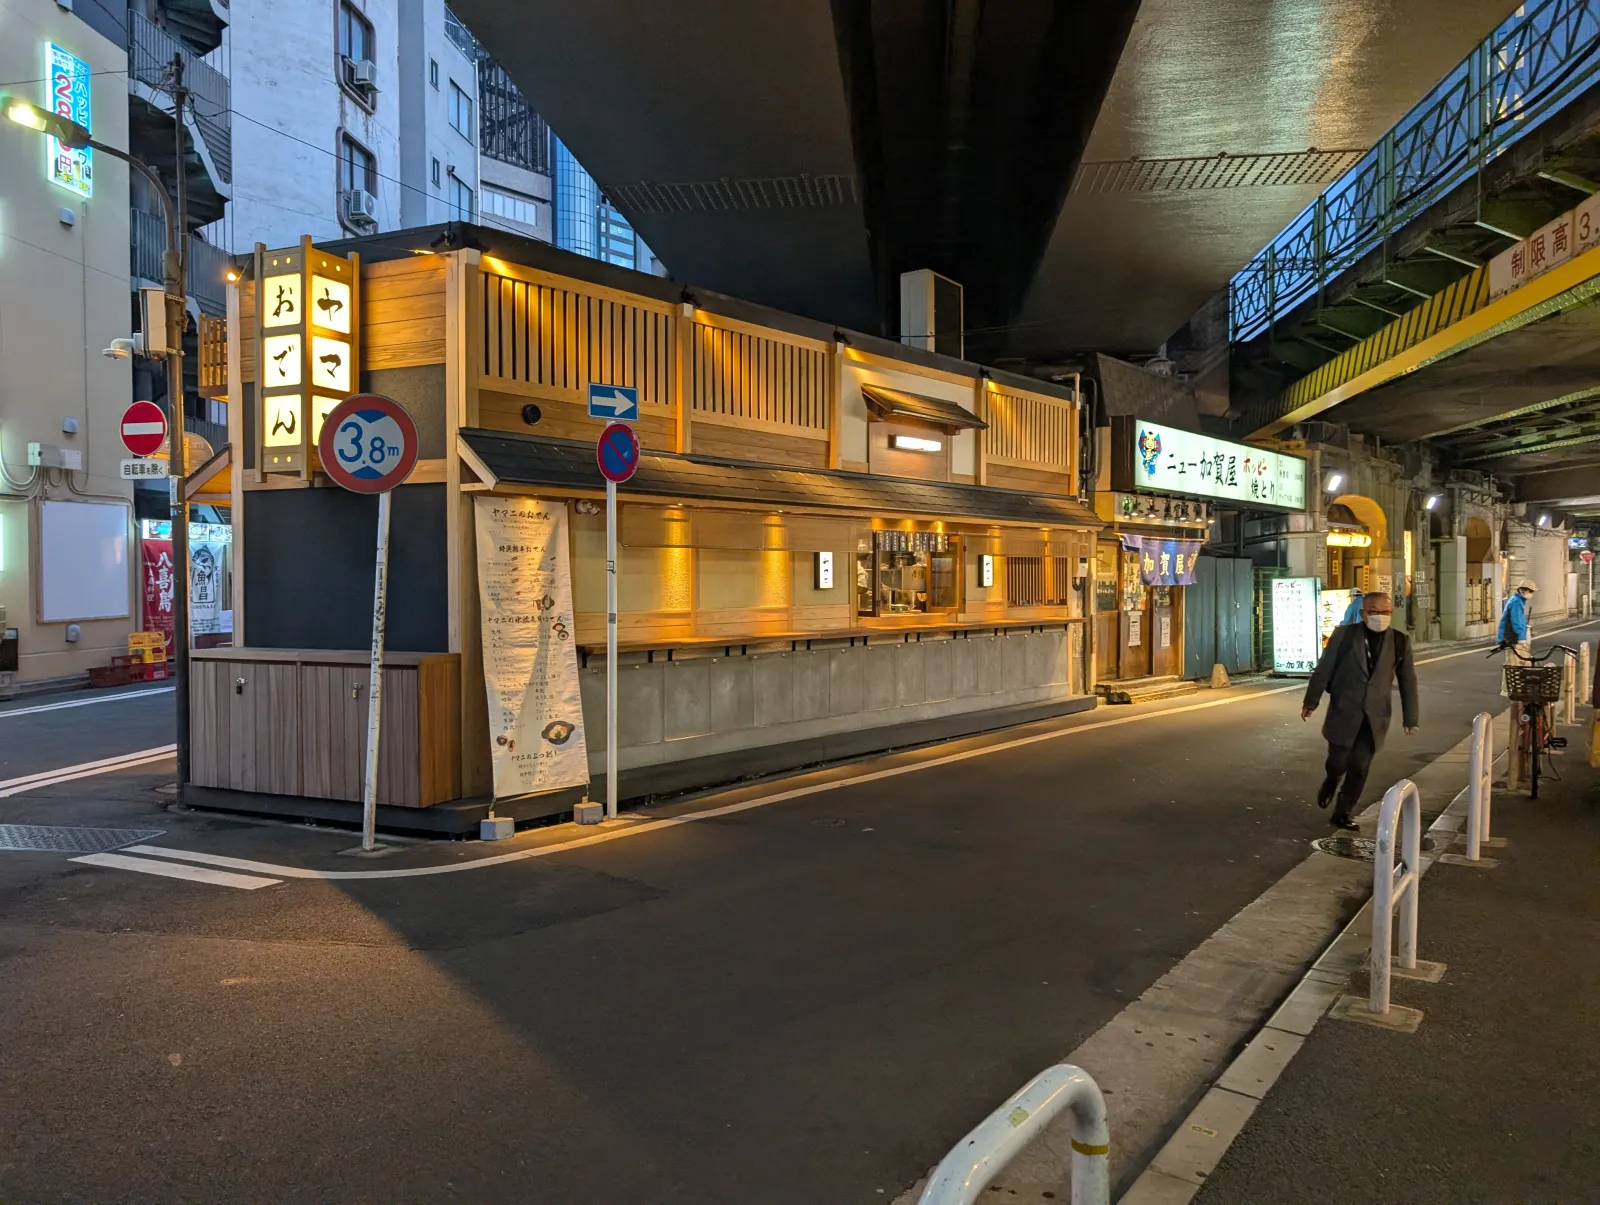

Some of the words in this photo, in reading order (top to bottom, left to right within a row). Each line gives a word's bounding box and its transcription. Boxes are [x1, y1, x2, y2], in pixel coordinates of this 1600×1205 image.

[57, 73, 72, 173] 28円
[75, 82, 87, 180] ハッピワー
[272, 284, 297, 437] おでん
[317, 287, 344, 420] ヤマ
[338, 421, 400, 465] 3.8m
[124, 463, 163, 475] 自転車を除く
[1167, 451, 1238, 487] ニュー加賀屋
[1251, 478, 1275, 501] 焼とり
[492, 508, 551, 521] ヤマニのおでん
[1143, 550, 1185, 576] 加賀屋
